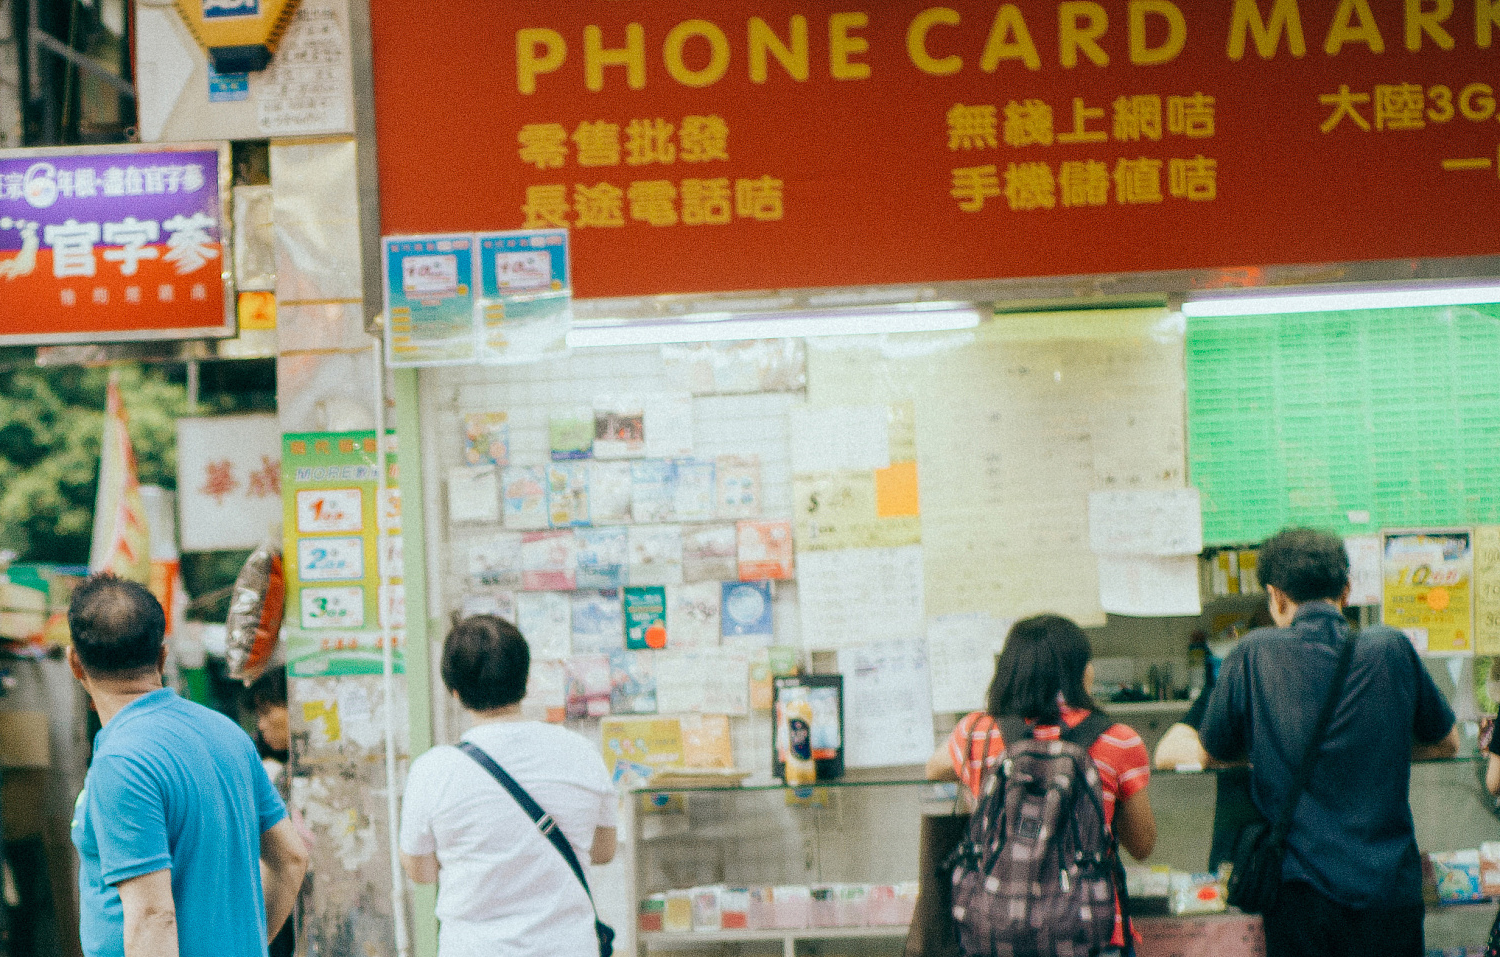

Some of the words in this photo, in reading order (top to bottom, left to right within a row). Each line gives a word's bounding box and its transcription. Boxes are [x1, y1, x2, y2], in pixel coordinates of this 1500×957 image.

[515, 12, 872, 96] PHONE
[905, 0, 1188, 76] CARD
[1318, 82, 1500, 134] 大陸3G
[517, 113, 730, 170] 零售批發
[520, 174, 785, 229] 長途電話咭
[950, 155, 1218, 213] 手機儲值咭
